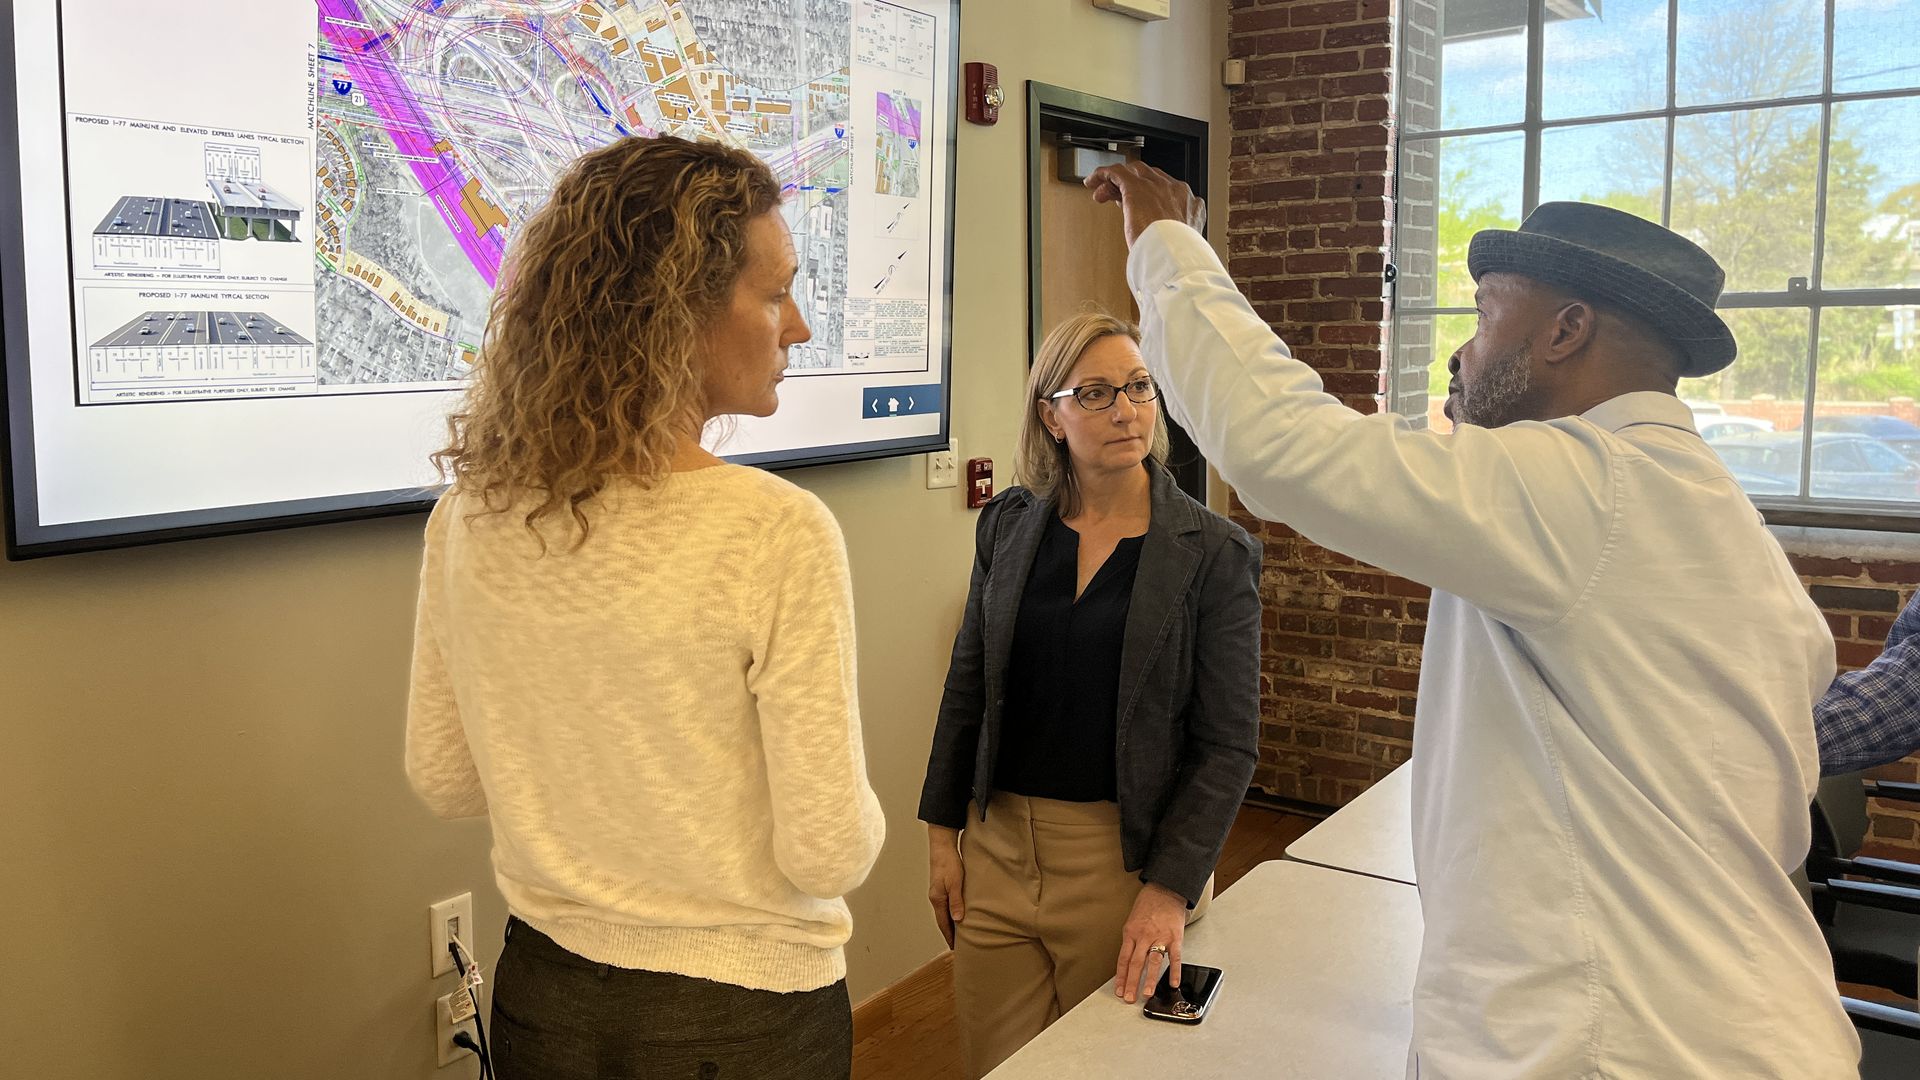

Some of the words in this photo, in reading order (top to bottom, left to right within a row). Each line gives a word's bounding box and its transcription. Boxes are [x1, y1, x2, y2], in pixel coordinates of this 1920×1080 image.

[307, 53, 315, 78] SHEET
[337, 81, 348, 90] 77
[307, 81, 315, 130] MATCHLINE
[354, 95, 362, 103] 21
[75, 116, 109, 125] PROPOSED
[129, 121, 160, 130] MAINLINE
[180, 126, 208, 135] ELEVATED
[211, 130, 235, 138] EXPRESS
[237, 132, 255, 140] LANES
[257, 135, 279, 143] TYPICAL
[280, 137, 304, 145] SECTION
[138, 291, 172, 299] PROPOSED
